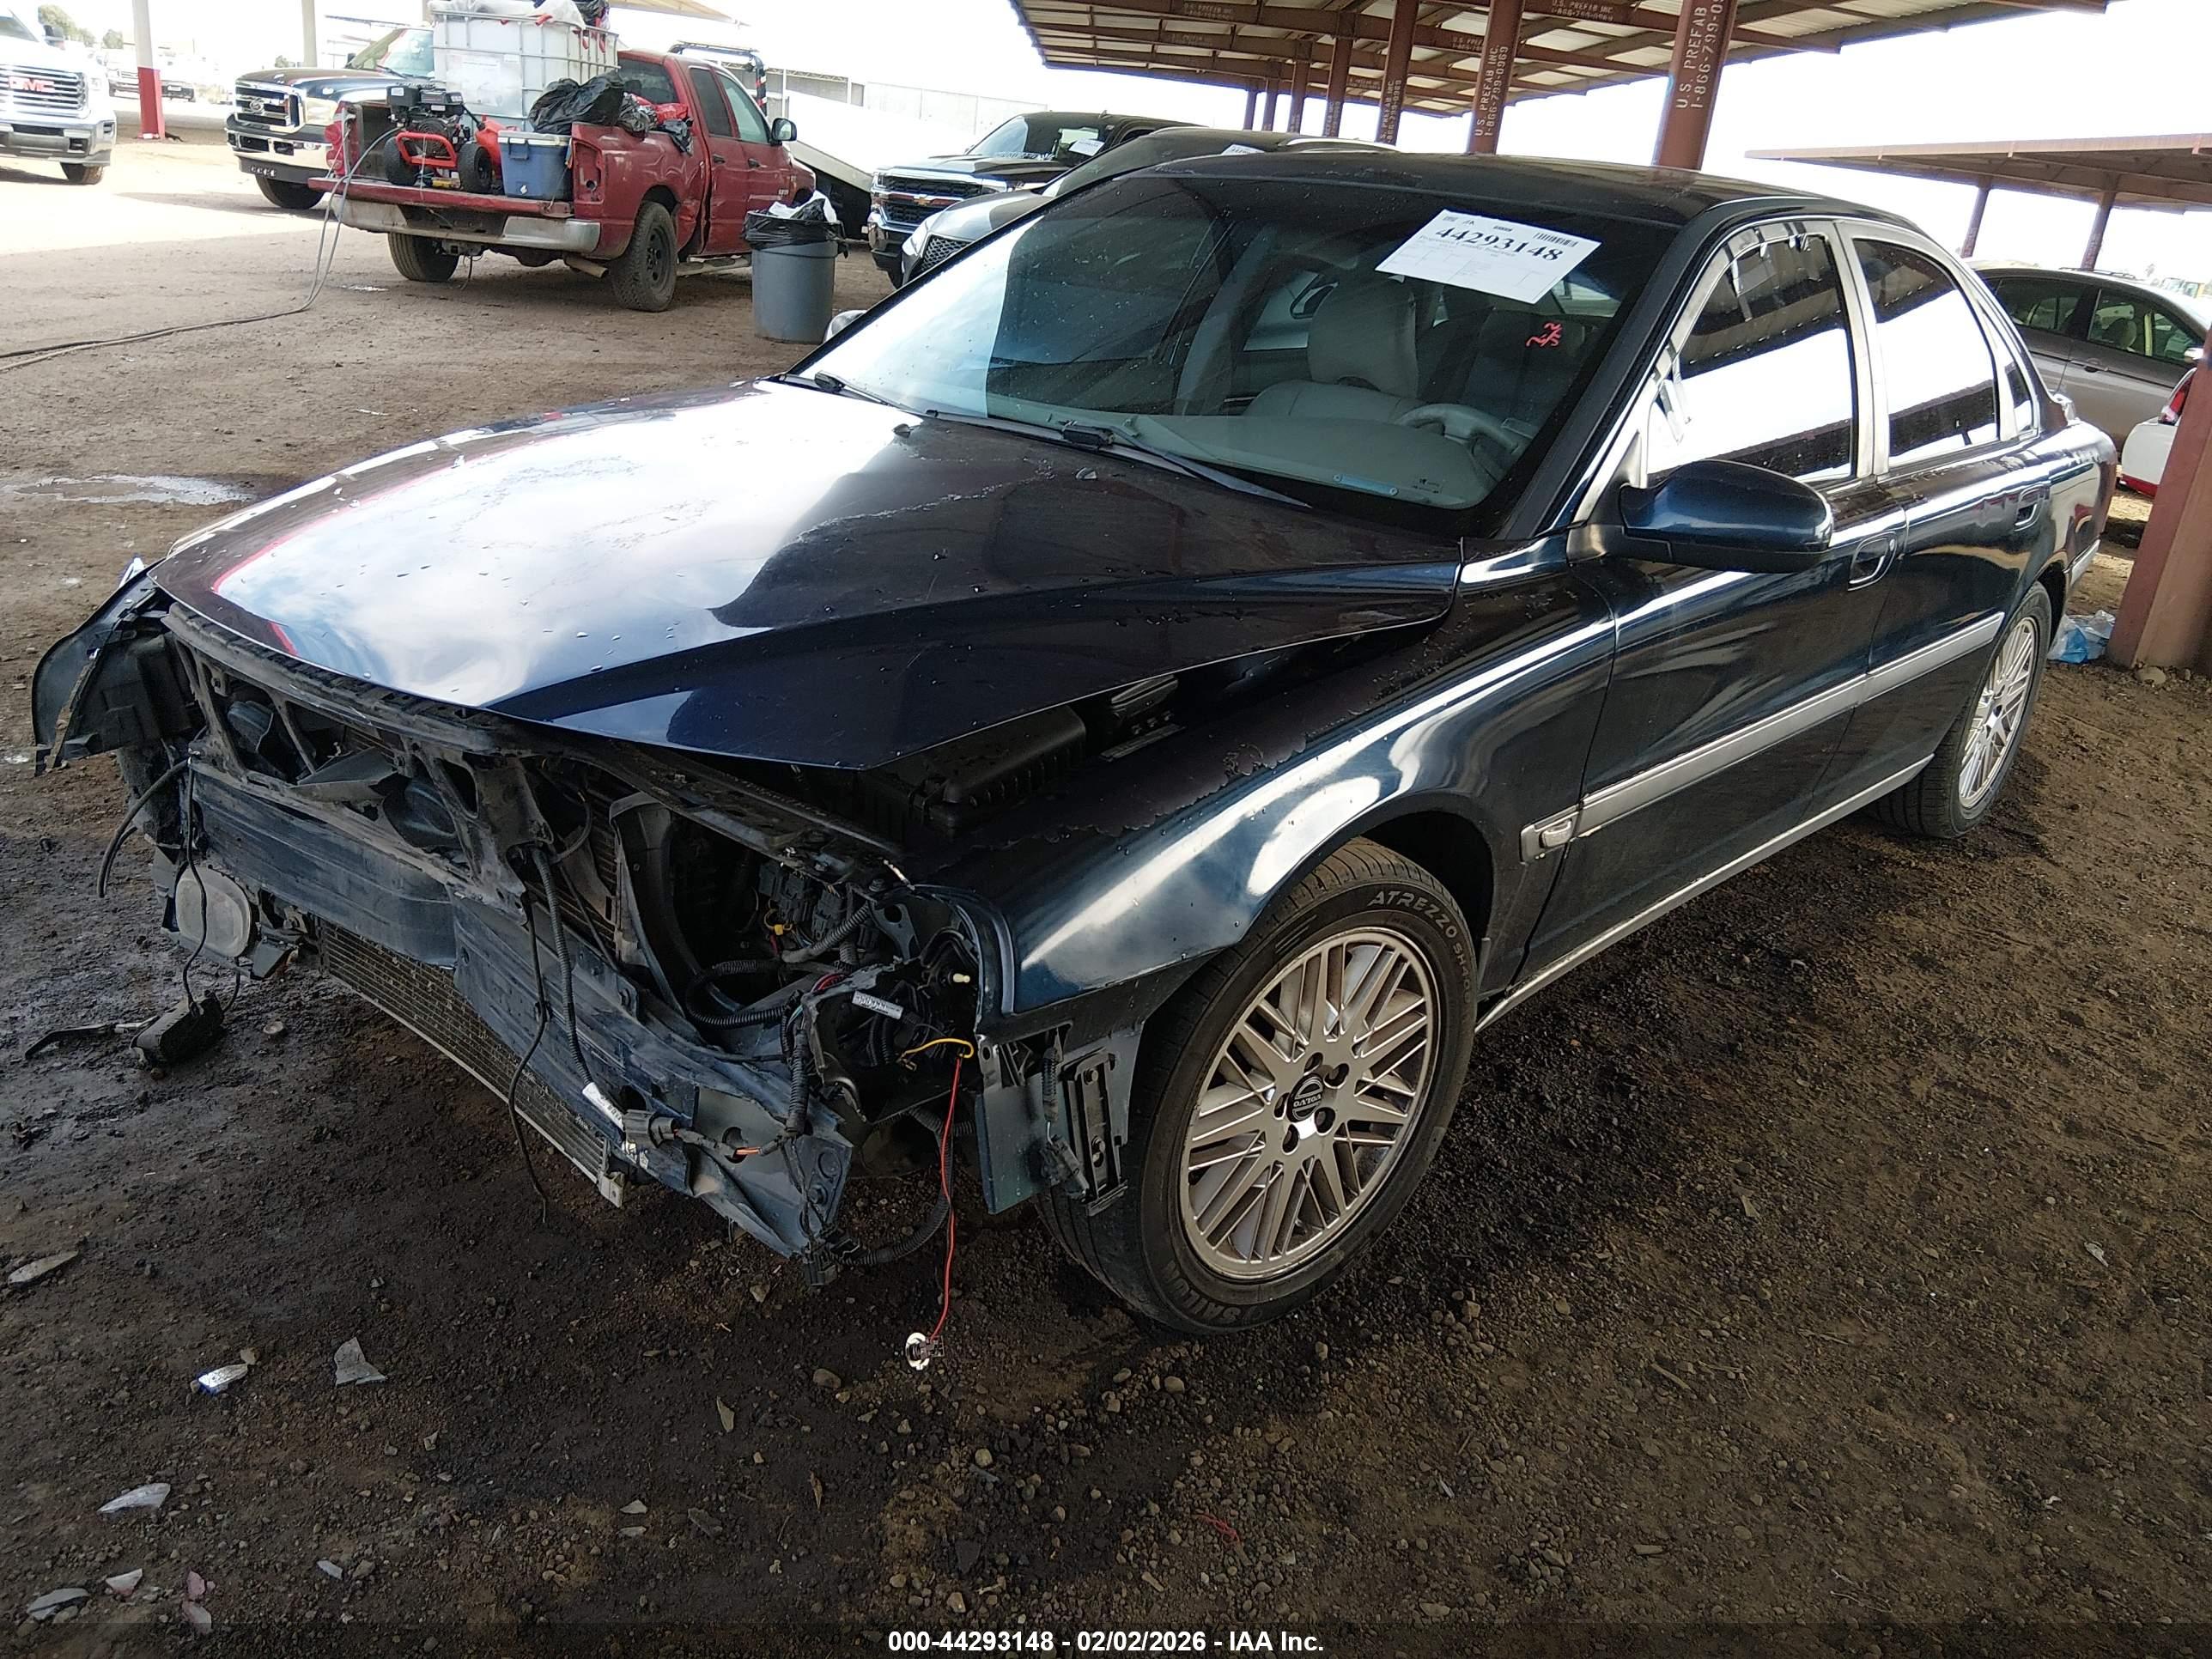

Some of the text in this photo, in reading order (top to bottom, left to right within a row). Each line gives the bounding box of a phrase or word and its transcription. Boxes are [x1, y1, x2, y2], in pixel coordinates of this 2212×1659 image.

[1676, 7, 1707, 108] U.S. PREFAB
[1691, 0, 1724, 108] 1-866-799-0
[8, 75, 55, 94] GMC
[1480, 70, 1494, 111] PREFAB
[1485, 46, 1509, 136] 1-866-799-0969
[1475, 116, 1486, 137] U.S.
[1435, 227, 1565, 261] 44293148
[1367, 890, 1458, 939] ATREZZO
[1292, 1093, 1322, 1108] VOLVO
